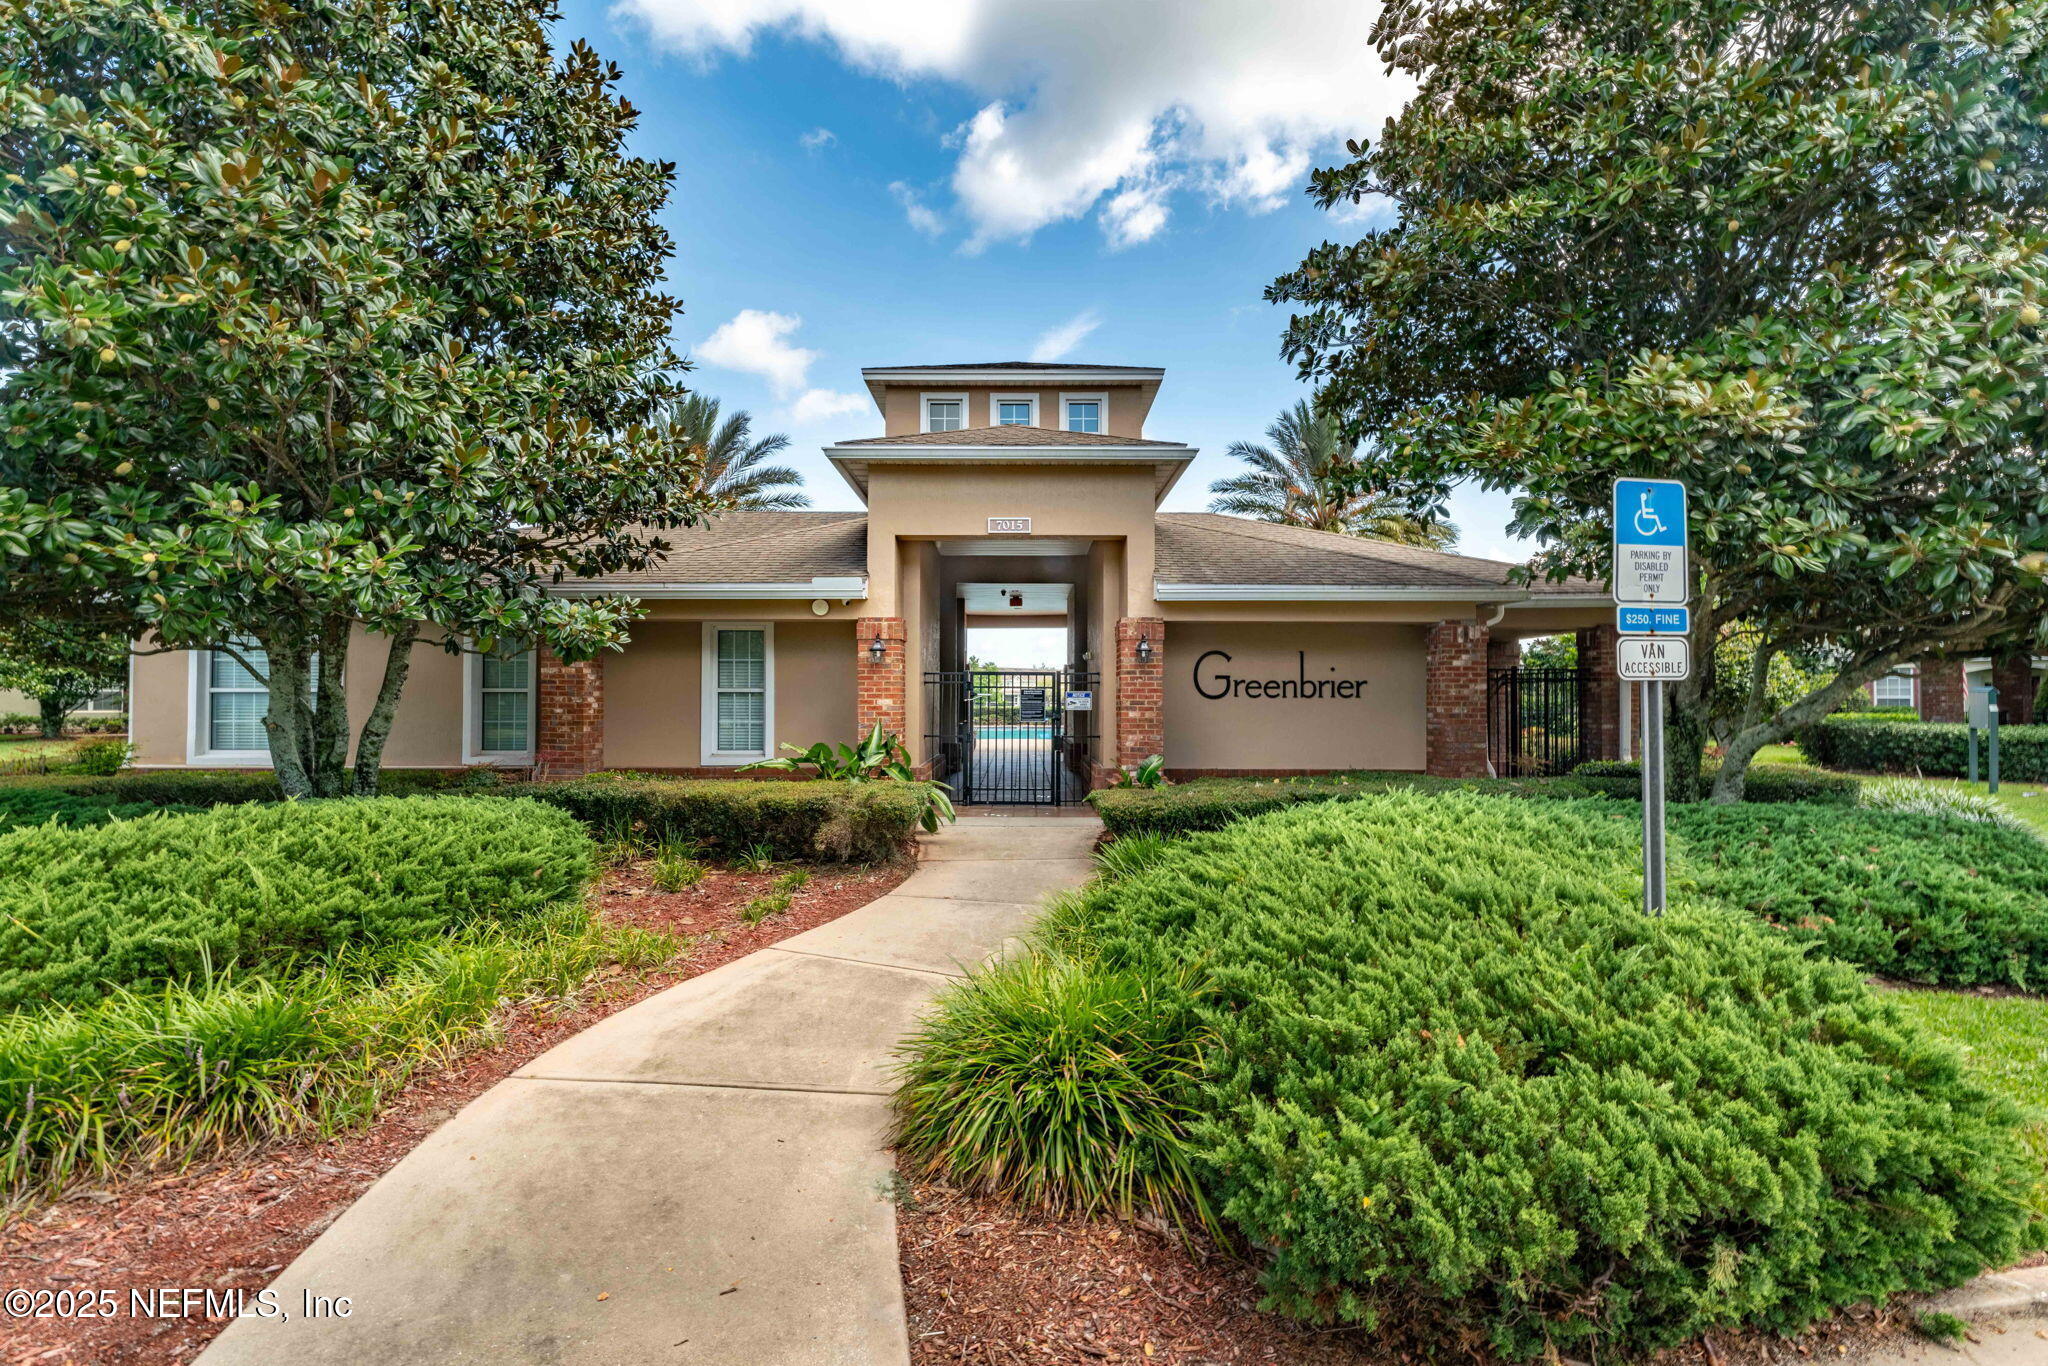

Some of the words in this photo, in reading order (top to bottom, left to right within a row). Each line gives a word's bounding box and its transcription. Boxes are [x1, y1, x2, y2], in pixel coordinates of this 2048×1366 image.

[996, 520, 1024, 530] 7015
[1630, 550, 1660, 560] PARKING
[1663, 551, 1672, 560] BY
[1634, 561, 1669, 571] DISABLED
[1639, 572, 1664, 582] PERMIT
[1643, 583, 1660, 593] ONLY
[1626, 614, 1652, 624] $250.
[1655, 614, 1680, 624] FINE
[1641, 644, 1665, 659] VAN
[1624, 661, 1683, 674] ACCESSIBLE
[1193, 650, 1368, 700] Greenbrier
